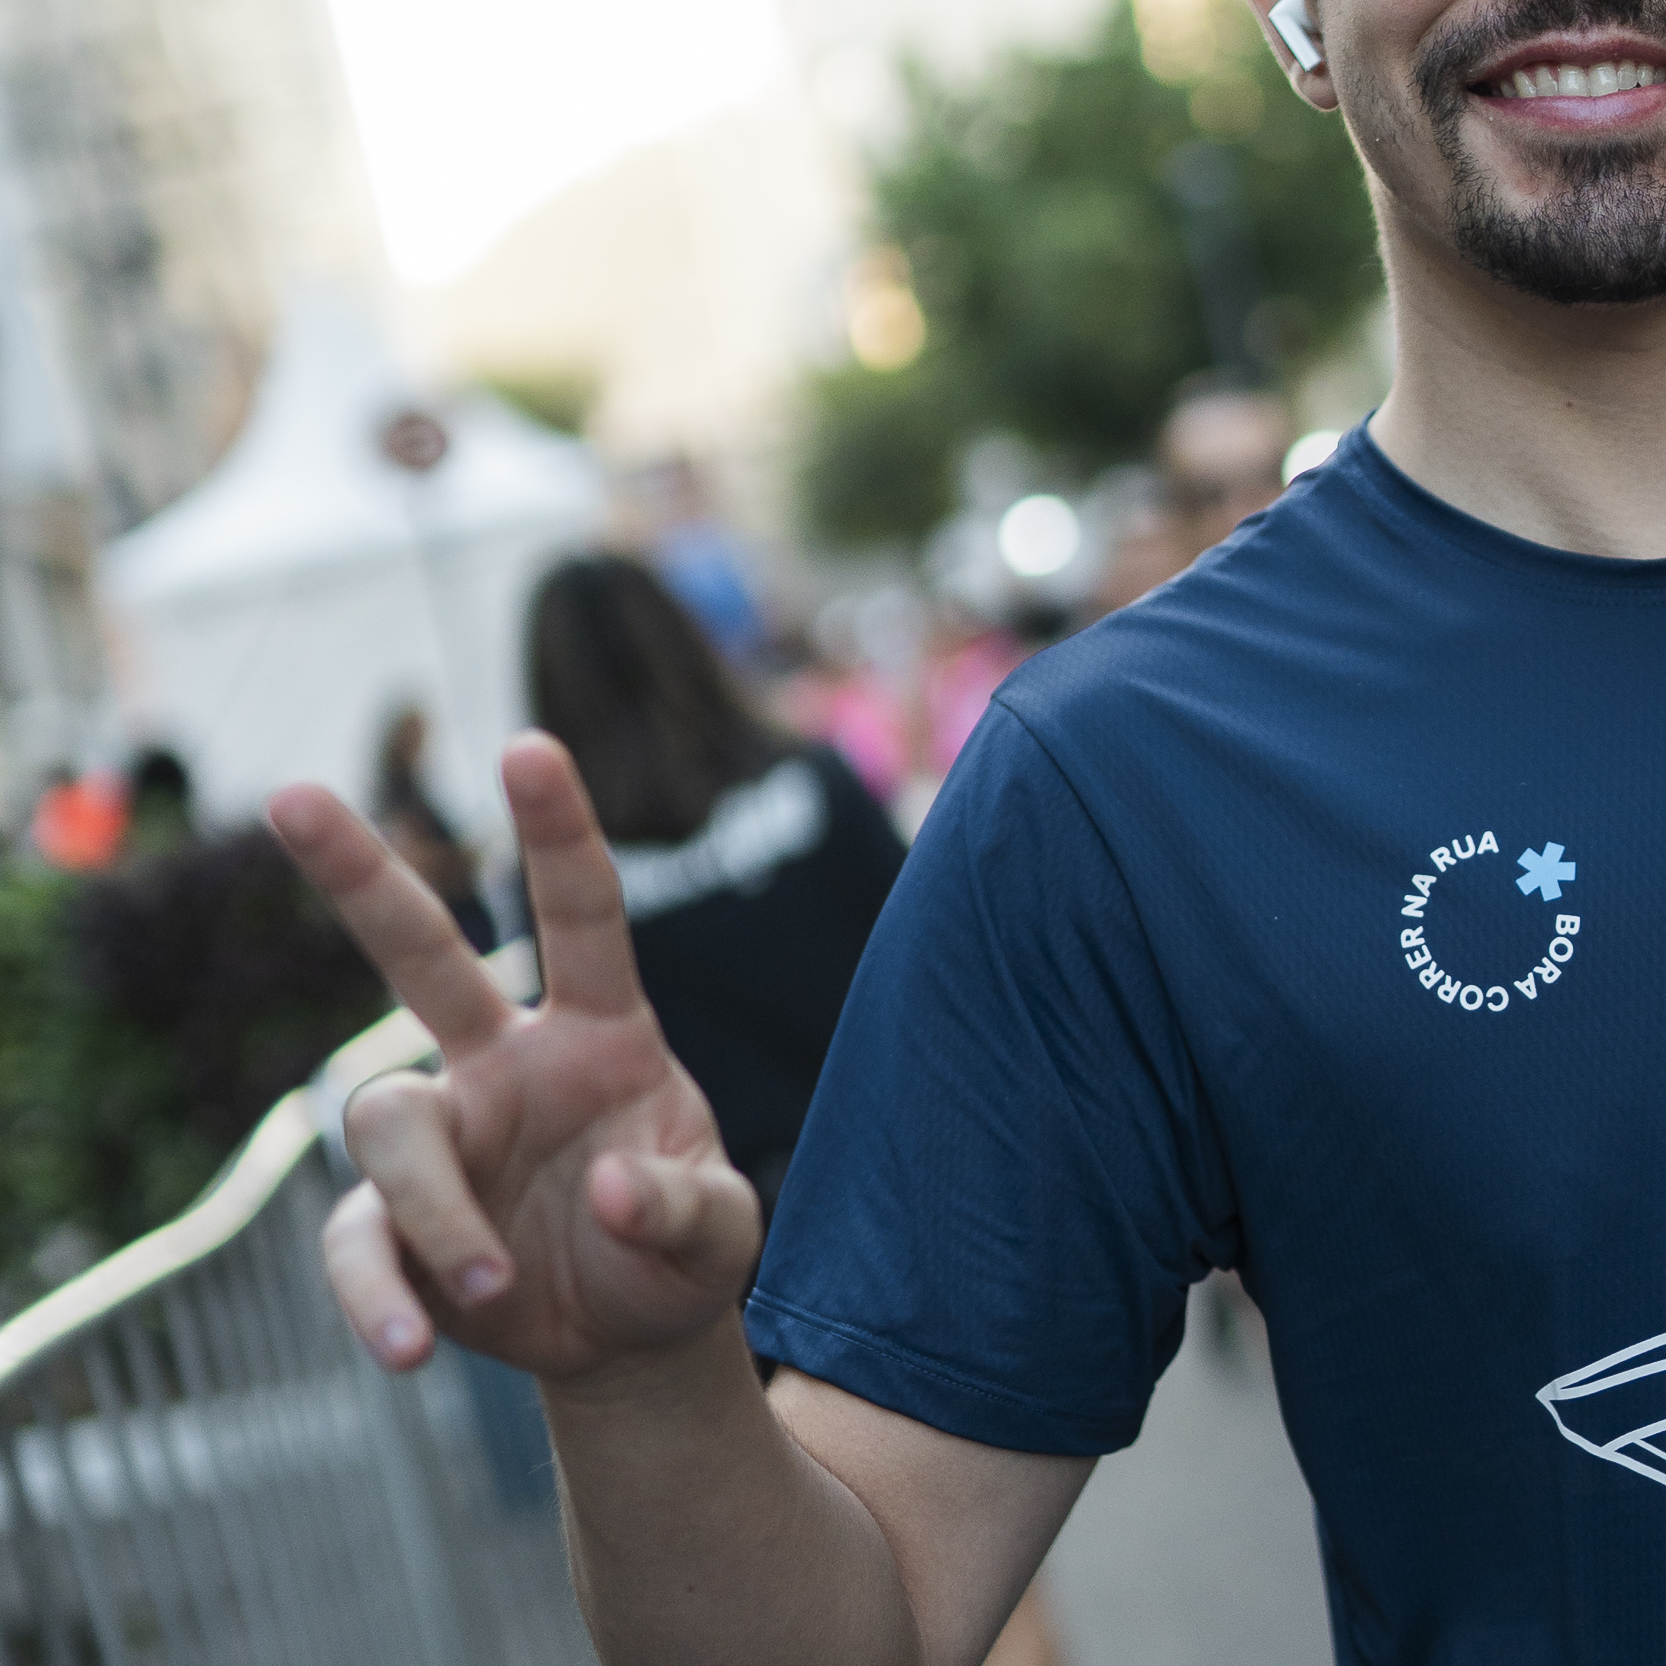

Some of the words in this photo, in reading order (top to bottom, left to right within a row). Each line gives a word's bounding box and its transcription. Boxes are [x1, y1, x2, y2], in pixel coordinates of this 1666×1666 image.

[1430, 830, 1499, 873] RUA
[1401, 873, 1437, 918] NA
[1400, 925, 1509, 1012] CORRER
[1513, 914, 1581, 1000] BORA
